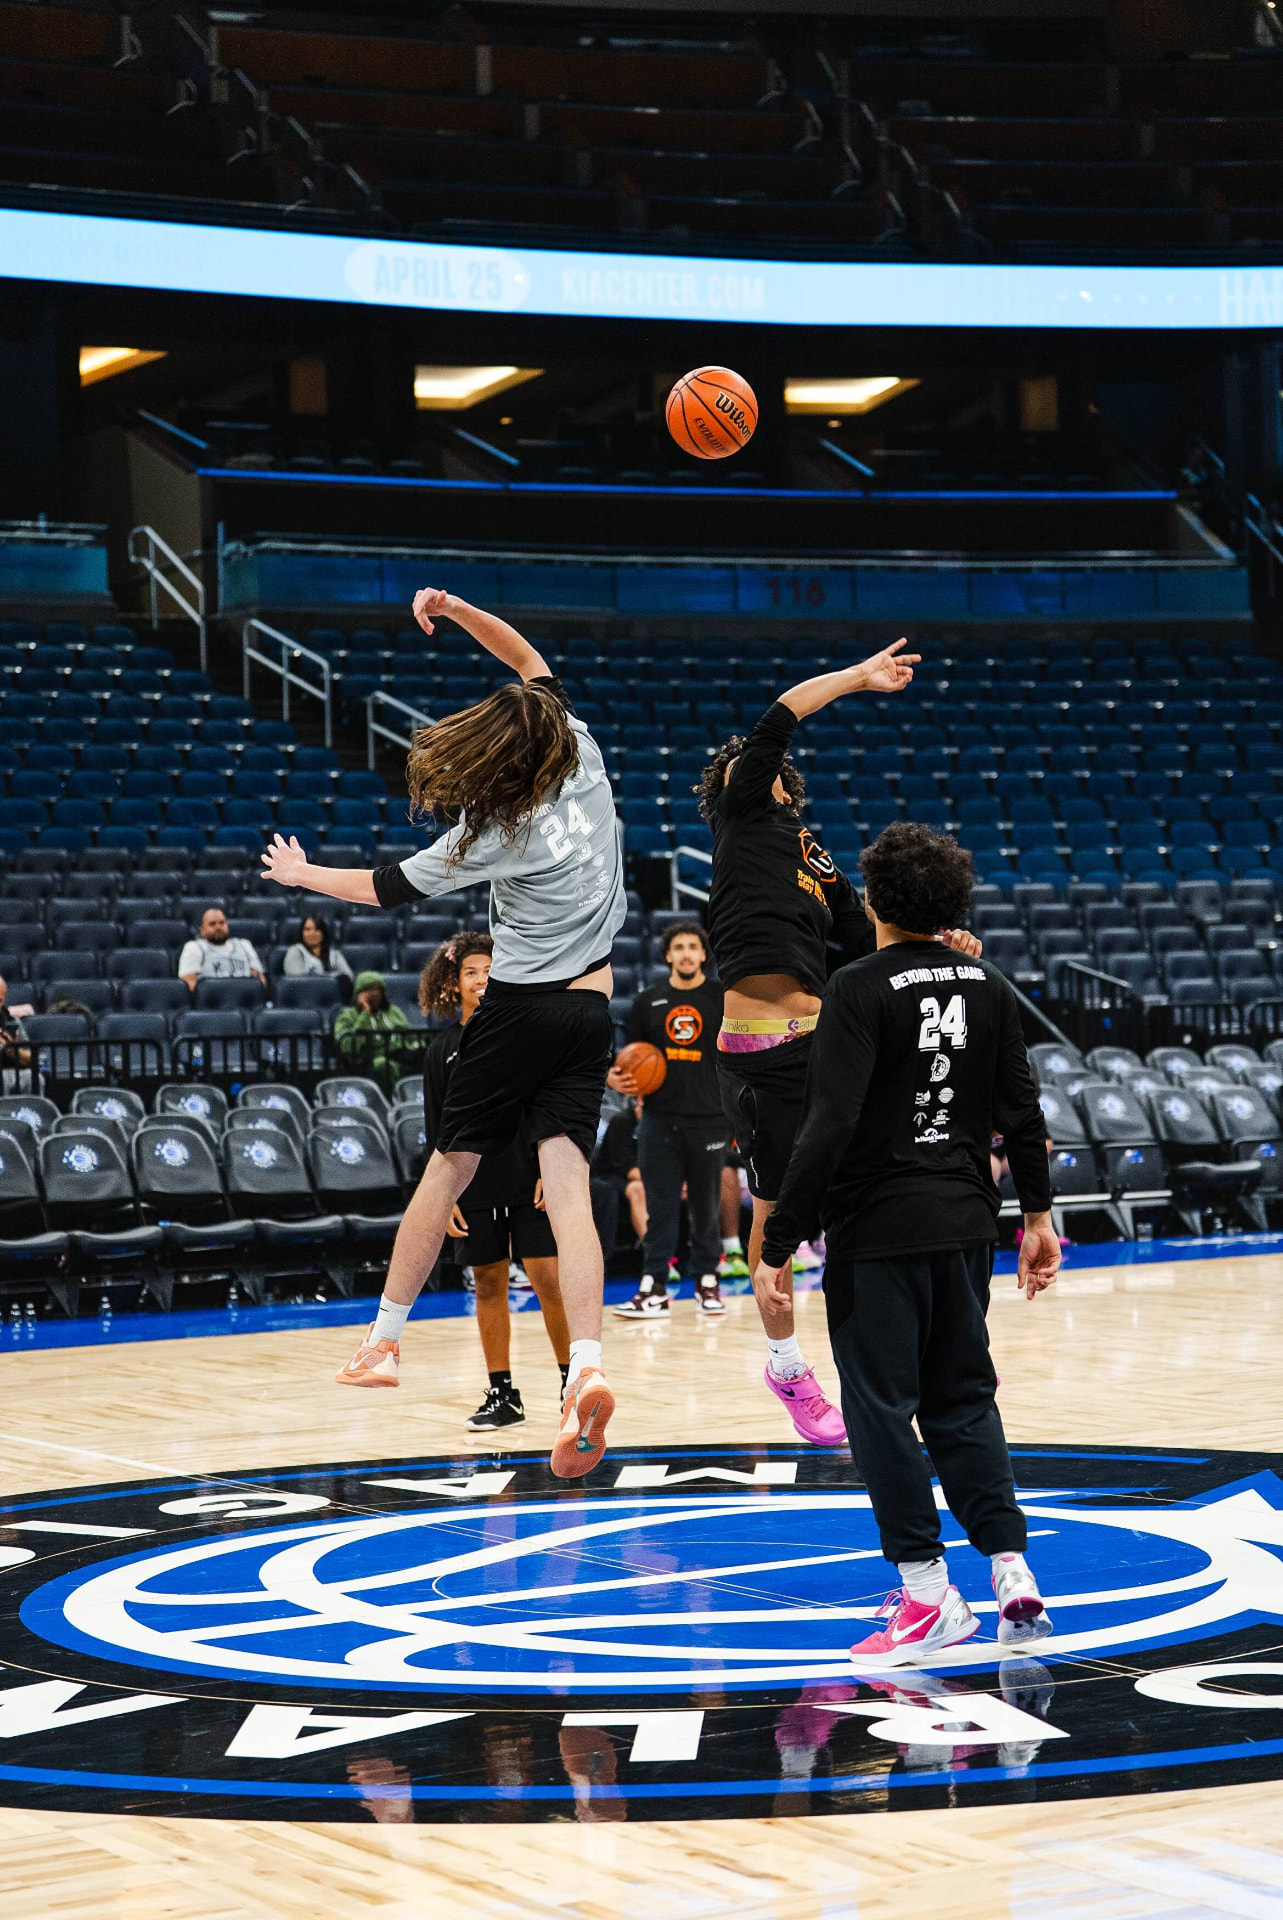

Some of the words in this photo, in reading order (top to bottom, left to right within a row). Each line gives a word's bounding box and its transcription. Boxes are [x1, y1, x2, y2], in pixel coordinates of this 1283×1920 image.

[374, 254, 457, 299] APRIL
[467, 261, 502, 302] 25
[562, 267, 765, 311] KIACENTER.COM
[715, 391, 752, 441] Wilson
[767, 577, 826, 606] 116
[539, 796, 597, 862] 24
[888, 967, 933, 991] BEYOND
[931, 966, 956, 982] THE
[955, 965, 987, 981] GAME
[918, 994, 968, 1051] 24
